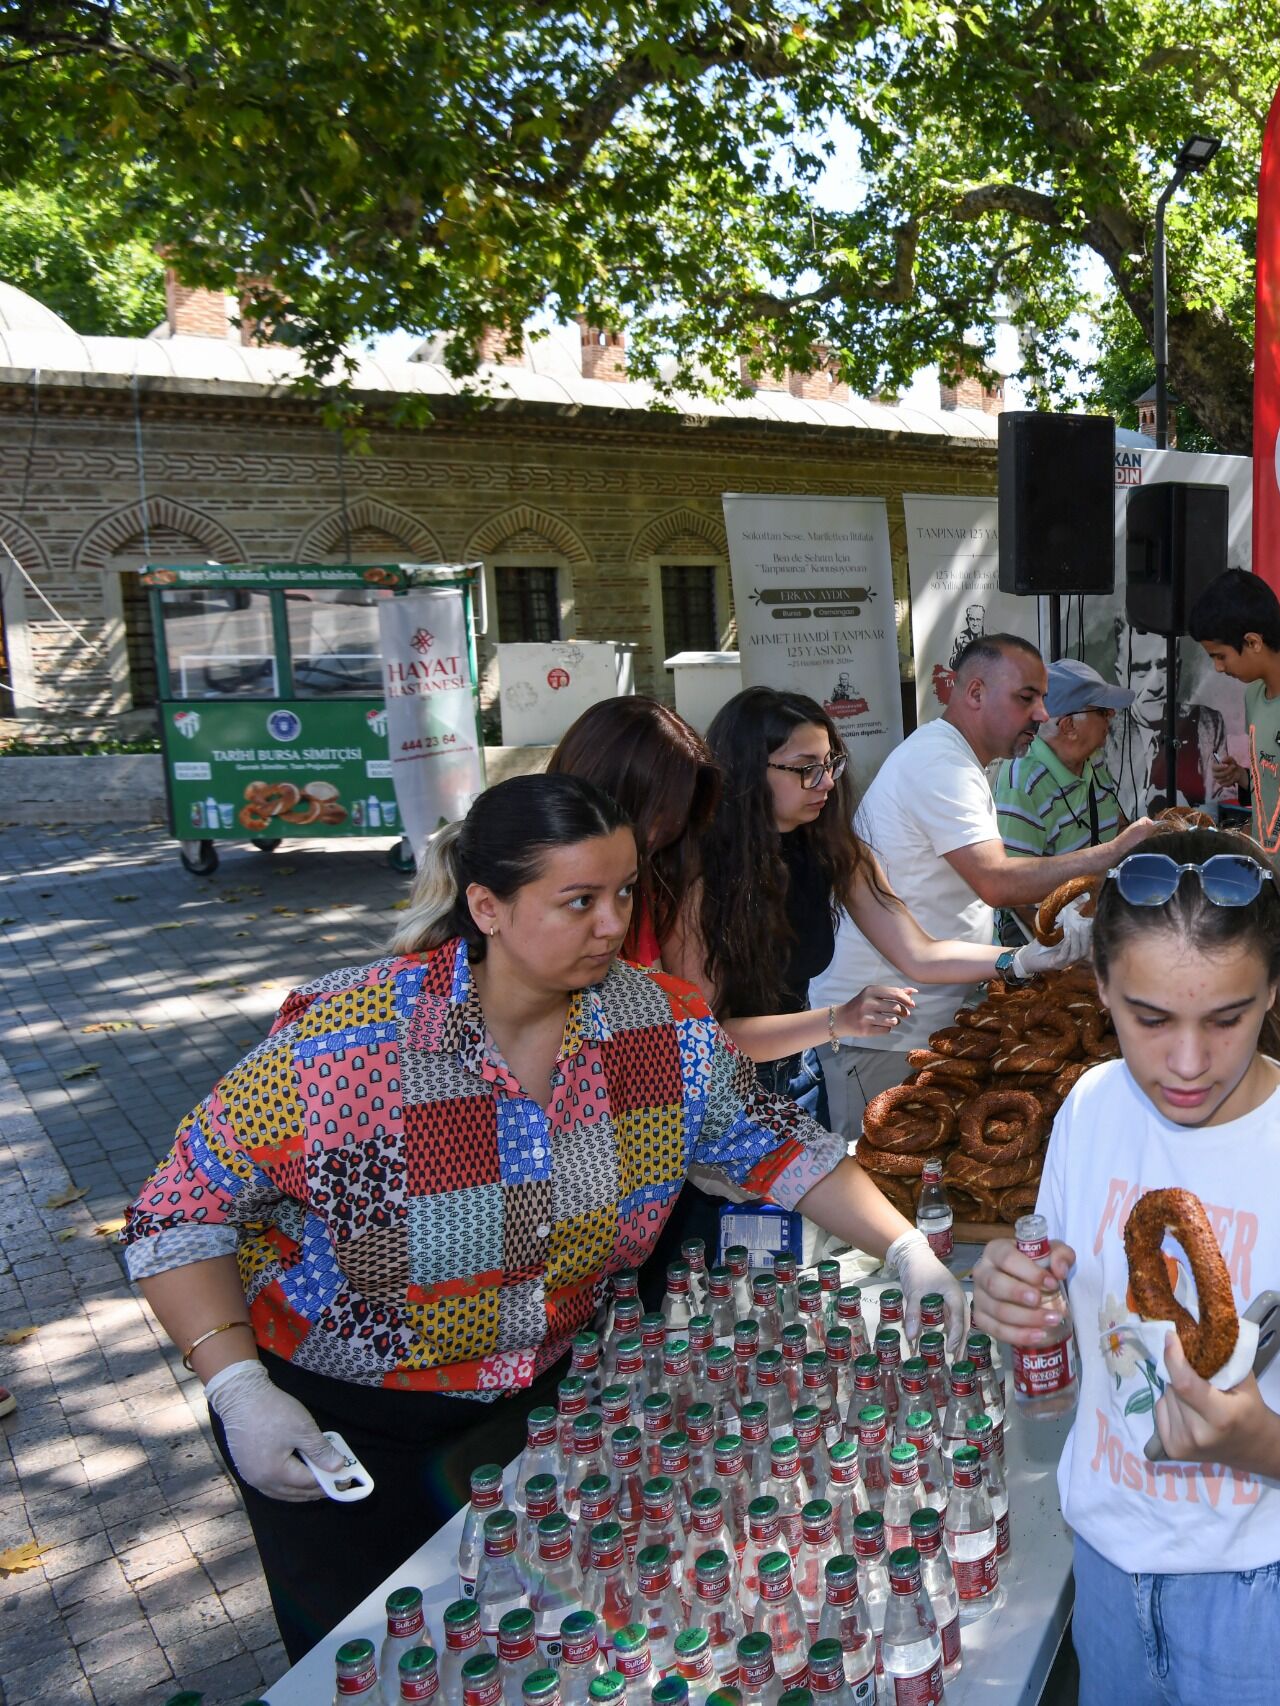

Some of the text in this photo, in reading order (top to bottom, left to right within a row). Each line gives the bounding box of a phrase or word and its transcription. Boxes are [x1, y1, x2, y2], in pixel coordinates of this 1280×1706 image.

[1115, 453, 1141, 467] KAN
[1115, 468, 1140, 483] DIN
[780, 590, 850, 601] ERKAN AYDIN
[749, 629, 886, 646] AHMET HAMDİ TANPINAR
[388, 656, 460, 682] HAYAT
[388, 675, 465, 699] HASTANESİ
[402, 734, 456, 751] 444 23 64
[258, 749, 301, 761] BURSA
[1023, 1353, 1063, 1370] Sultan
[1091, 1408, 1260, 1509] POSITIVE
[703, 1580, 726, 1591] Sultan
[568, 1643, 594, 1656] Sultan
[746, 1663, 771, 1678] Sultan
